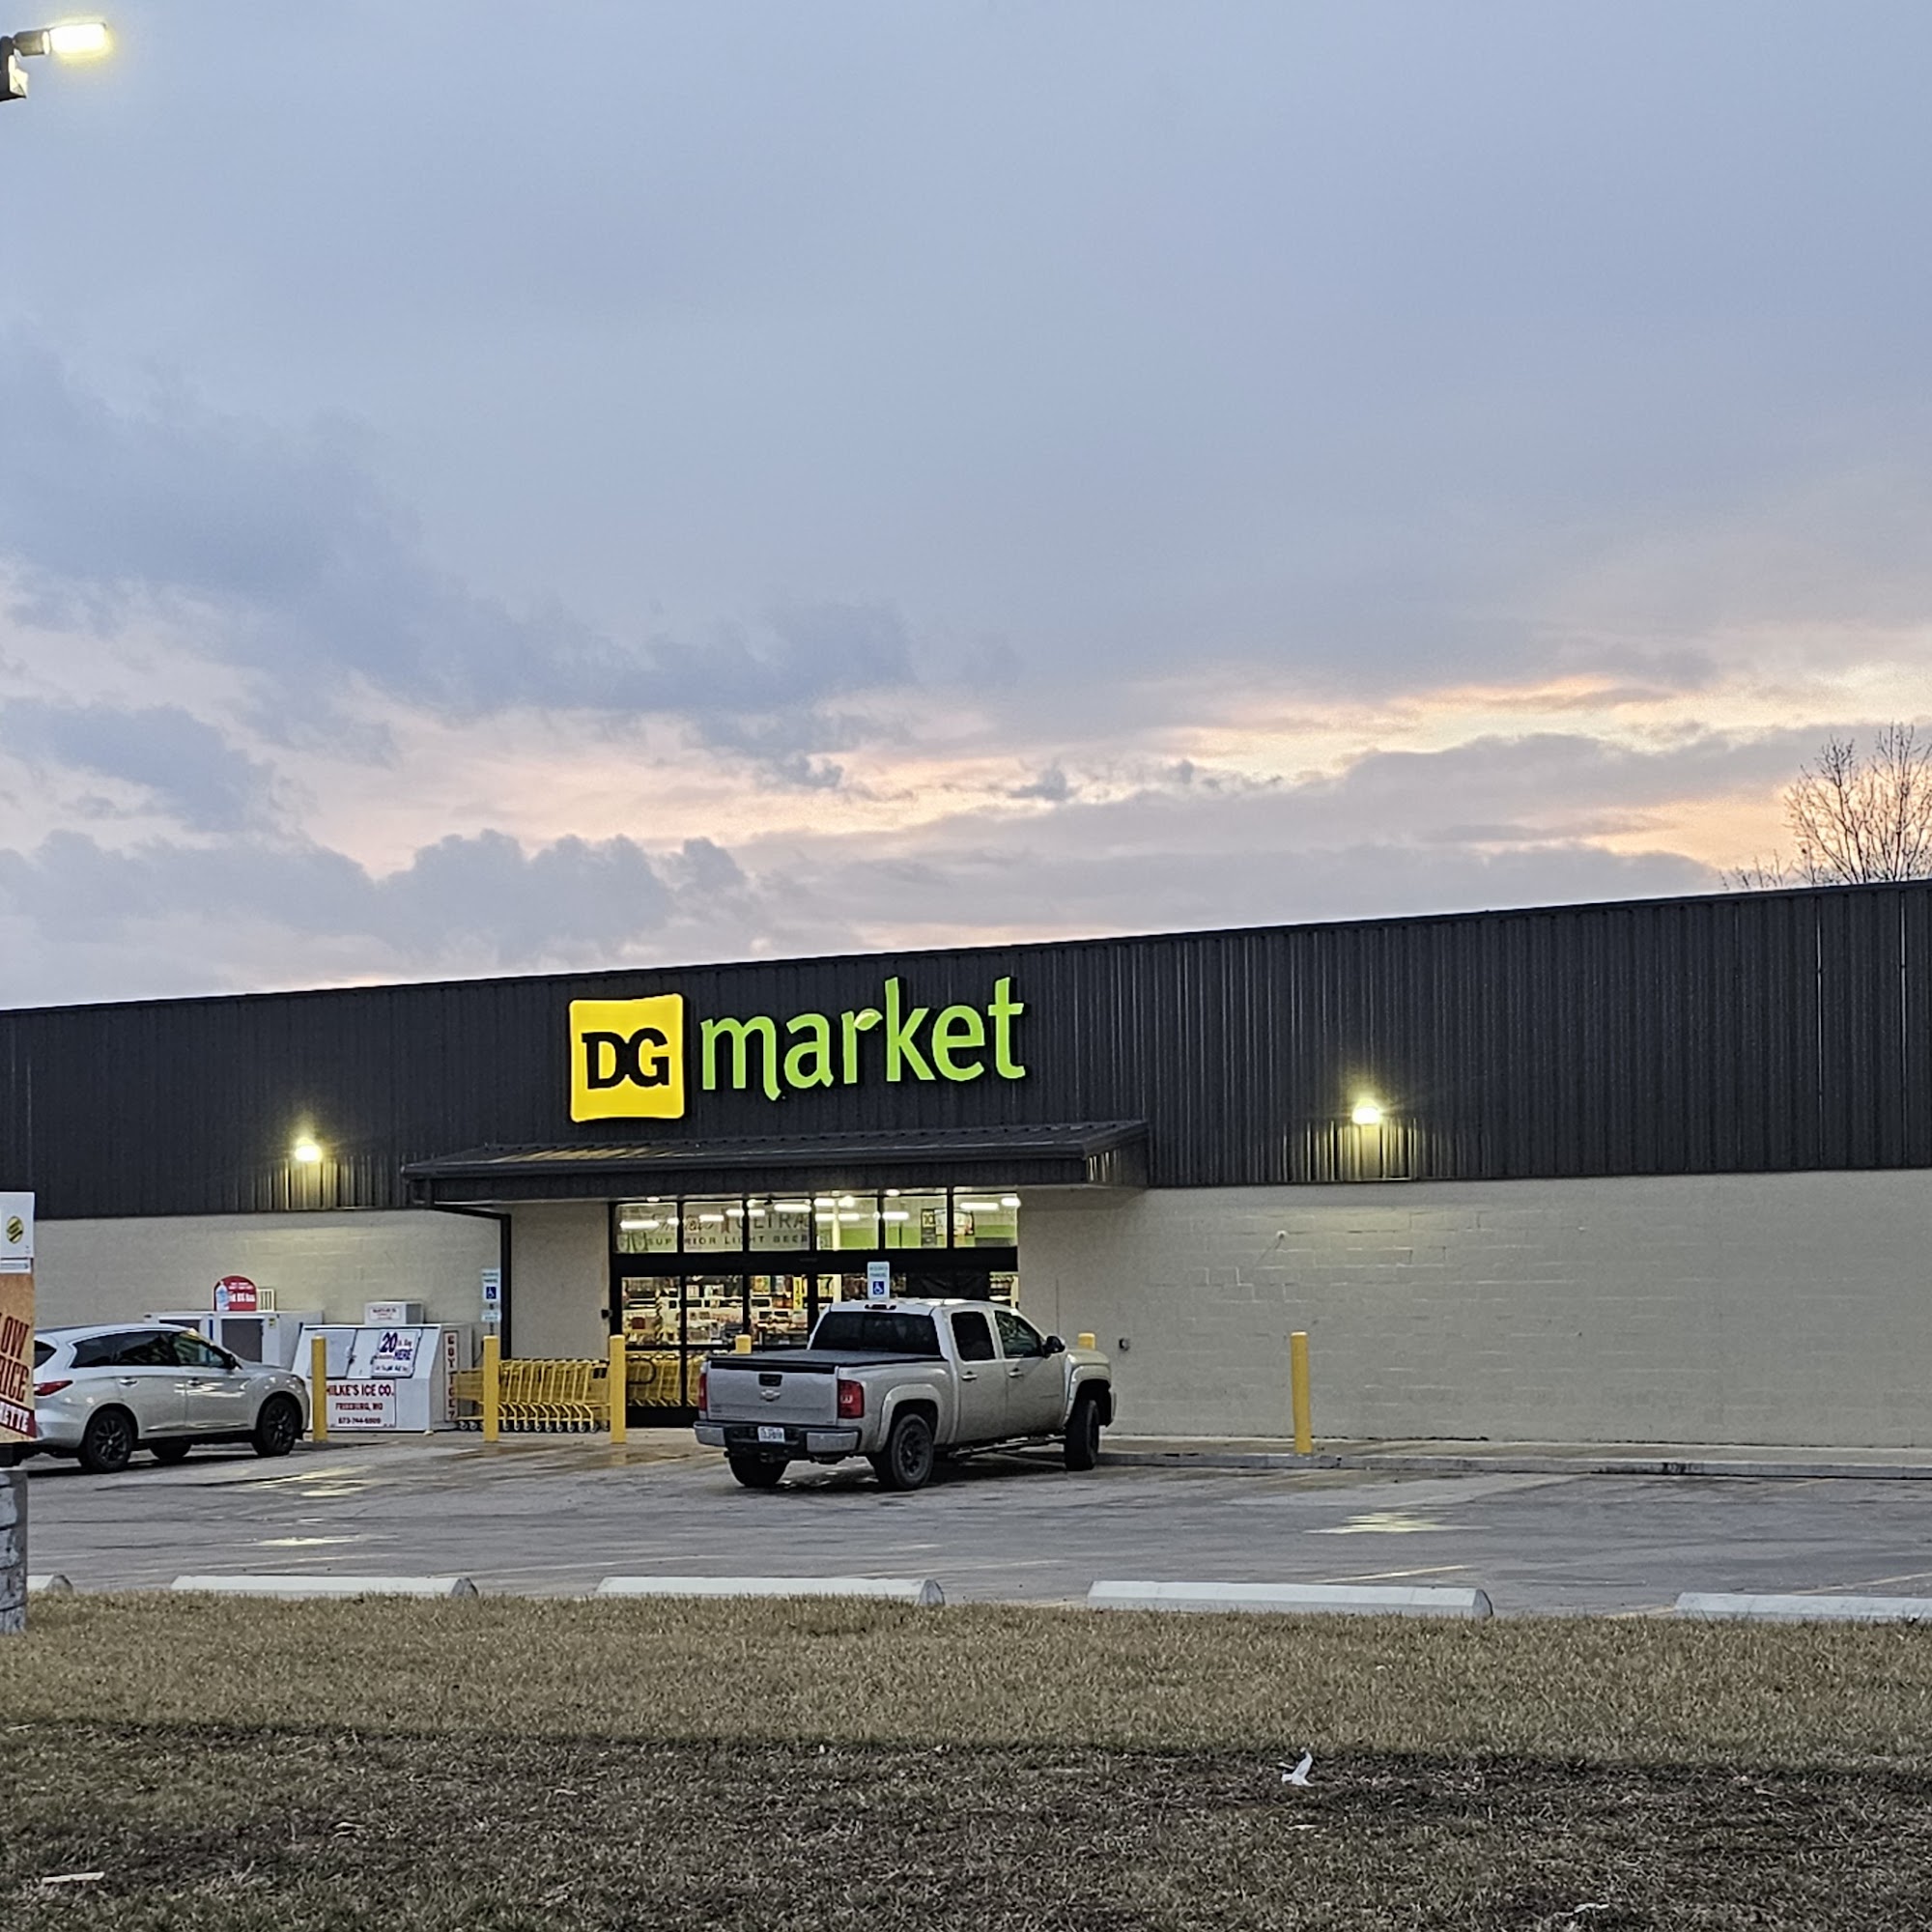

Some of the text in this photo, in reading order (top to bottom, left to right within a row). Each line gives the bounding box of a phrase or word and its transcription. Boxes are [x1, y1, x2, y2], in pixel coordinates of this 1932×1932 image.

[582, 977, 1026, 1101] DG market
[648, 1236, 717, 1245] SUPRIOR
[0, 1313, 30, 1359] OW
[379, 1331, 399, 1353] 20
[361, 1383, 377, 1397] ICE
[0, 1402, 30, 1433] ETTE
